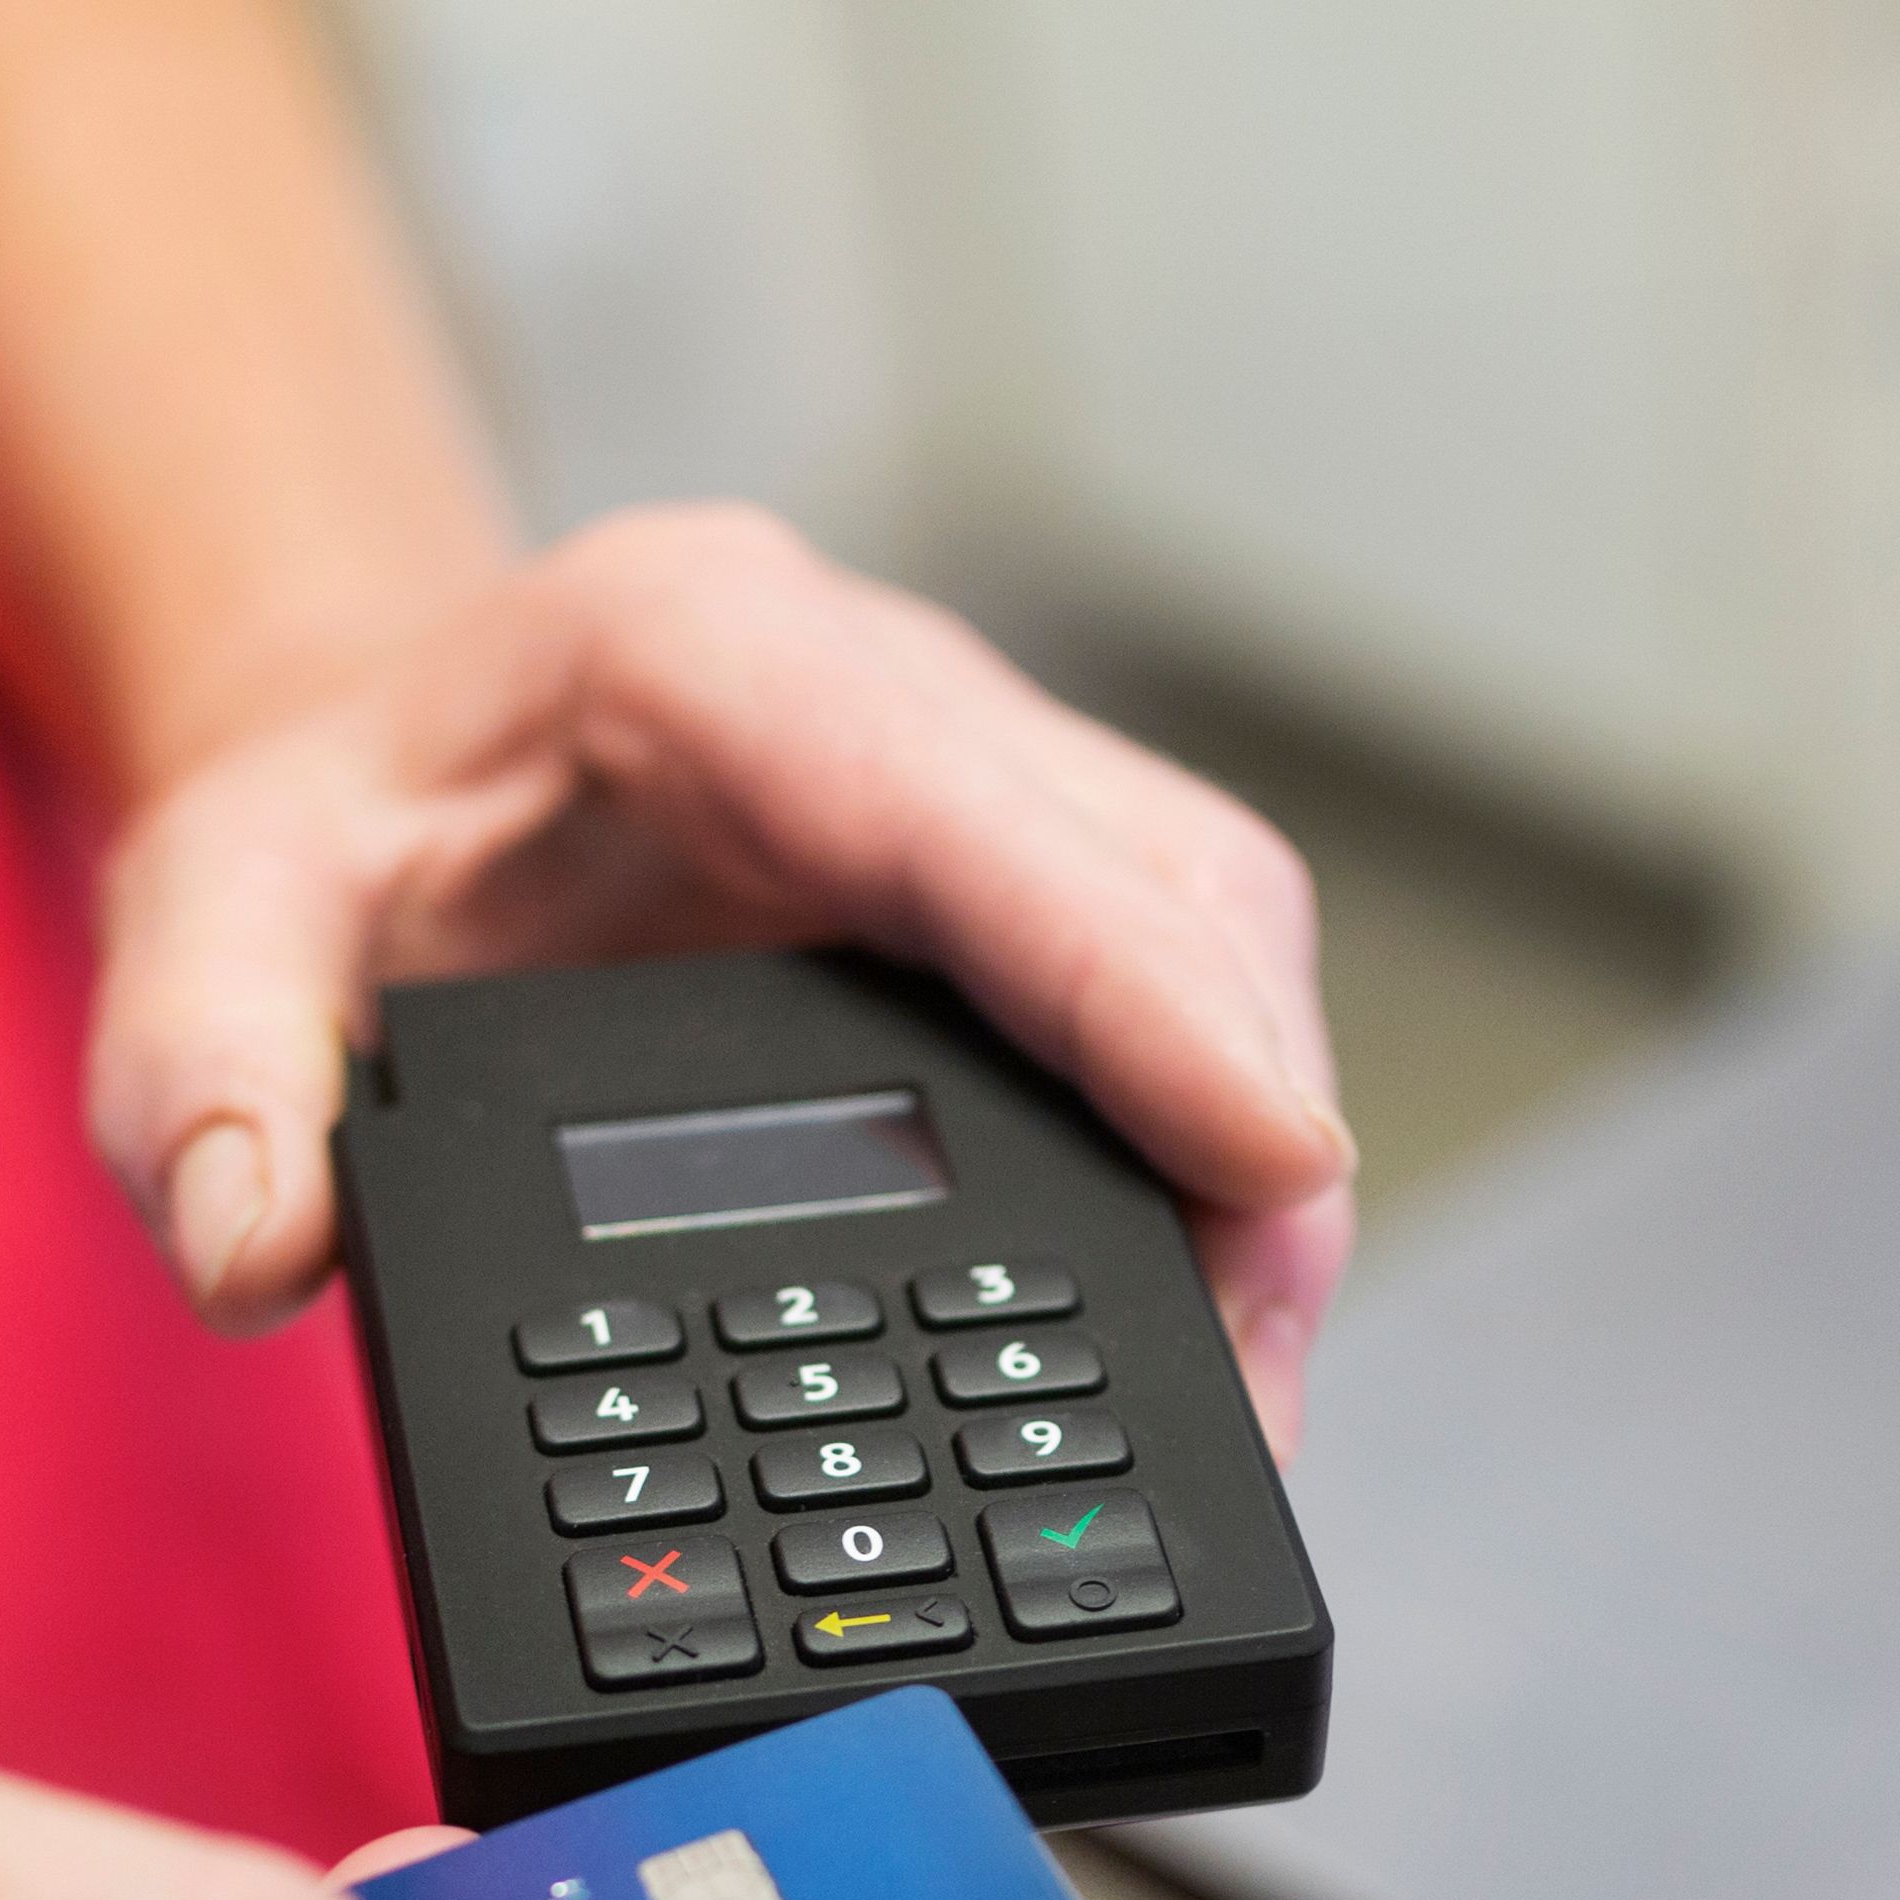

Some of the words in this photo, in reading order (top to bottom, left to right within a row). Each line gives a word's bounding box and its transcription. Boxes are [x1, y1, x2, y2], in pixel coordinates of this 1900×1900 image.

[580, 1308, 612, 1347] 1
[775, 1286, 820, 1327] 2
[969, 1264, 1015, 1306] 3
[595, 1386, 640, 1423] 4
[798, 1362, 839, 1403] 5
[997, 1341, 1042, 1381] 6
[611, 1465, 650, 1504] 7
[819, 1442, 863, 1478] 8
[1020, 1420, 1063, 1458] 9
[841, 1526, 885, 1563] 0
